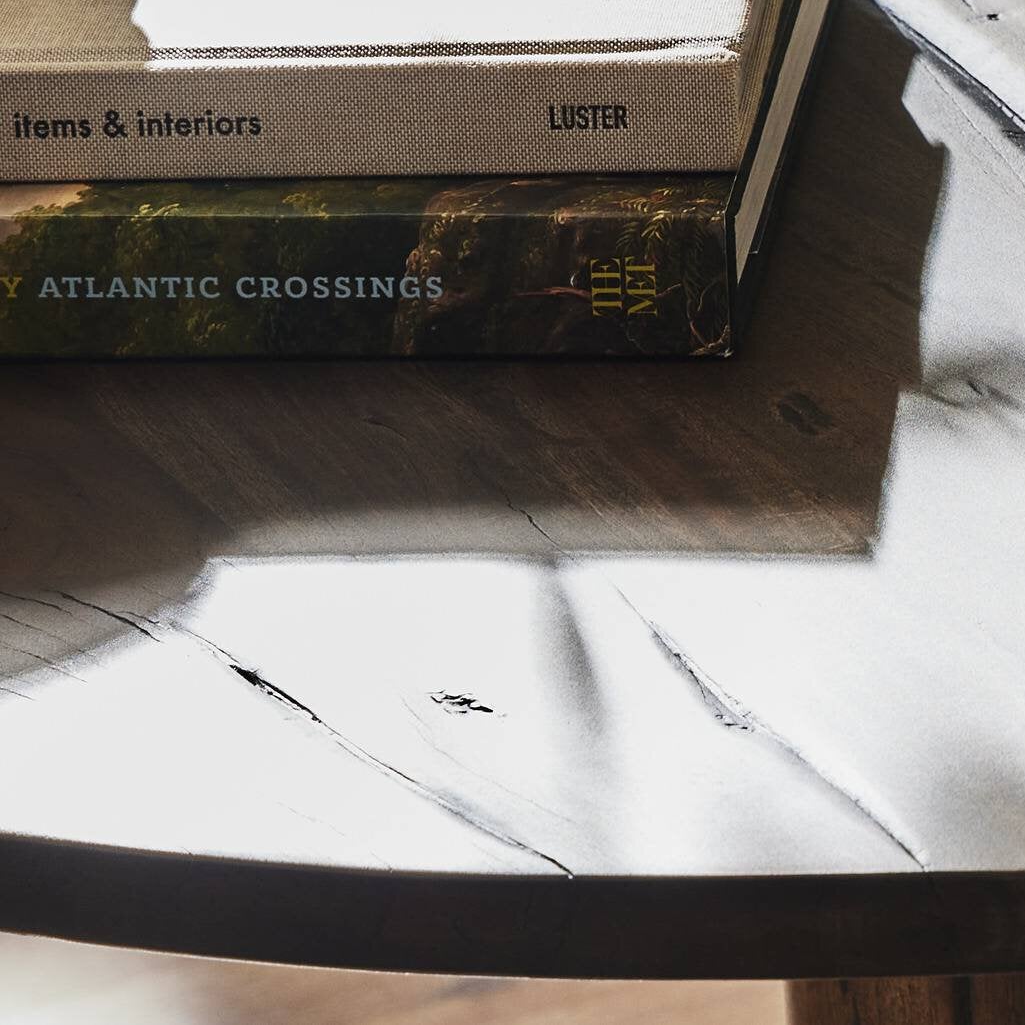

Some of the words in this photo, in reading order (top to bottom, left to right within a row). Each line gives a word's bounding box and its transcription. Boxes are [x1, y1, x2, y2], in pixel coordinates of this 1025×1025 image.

[13, 112, 92, 139] items
[102, 110, 128, 138] &
[136, 109, 262, 137] interiors
[548, 104, 628, 130] LUSTER
[38, 276, 220, 298] ATLANTIC
[235, 276, 443, 299] CROSSINGS
[590, 258, 623, 317] THE
[624, 256, 658, 317] MET
